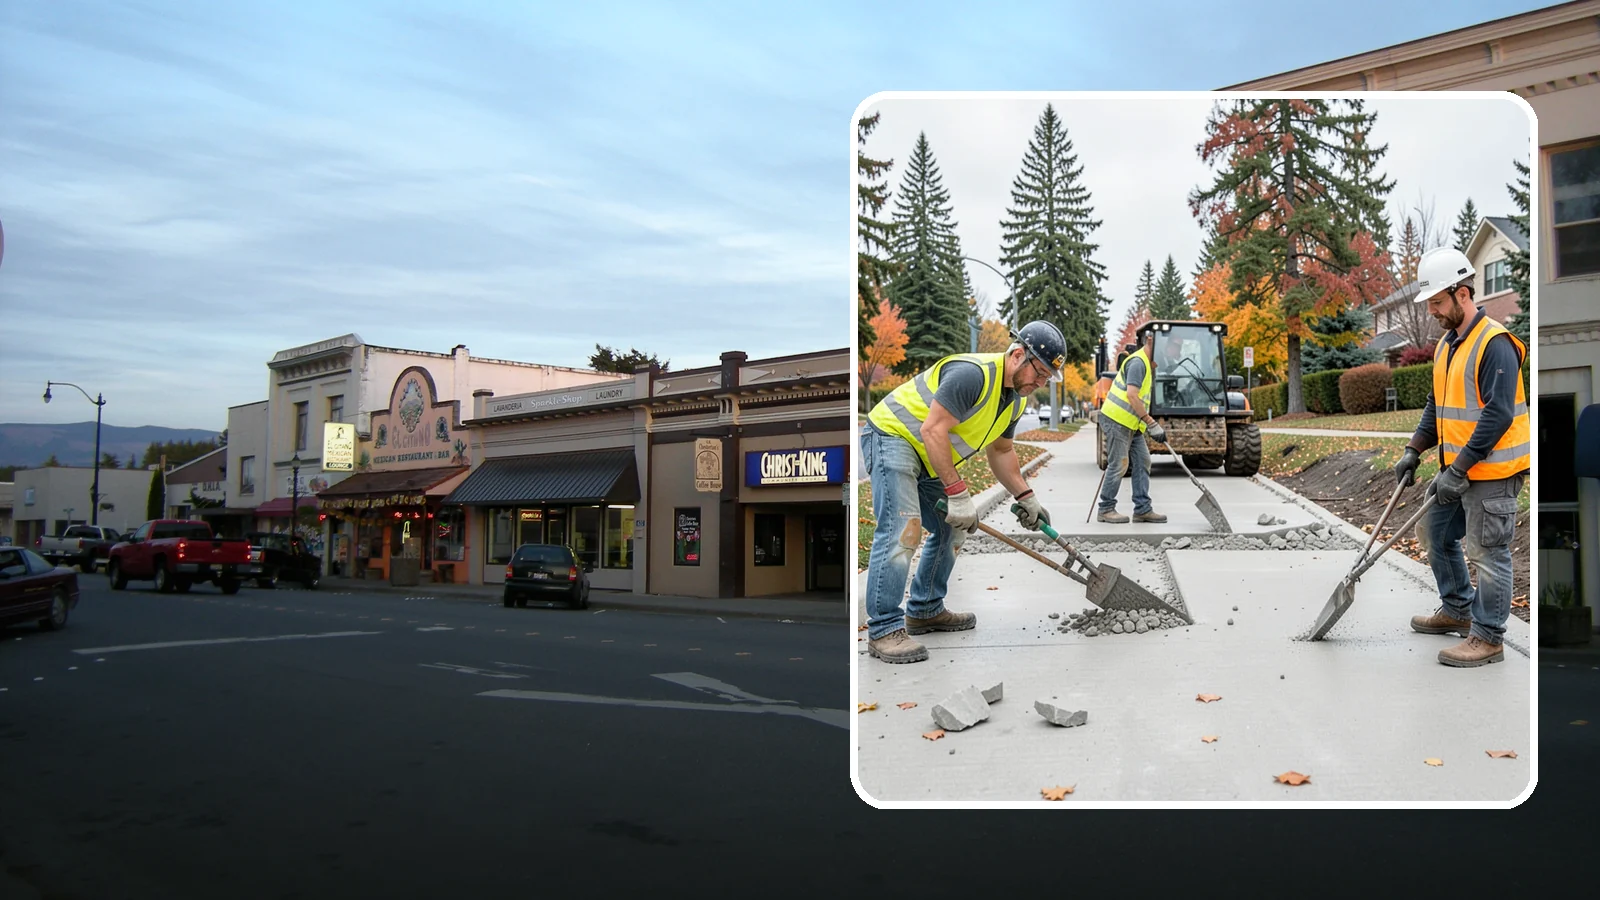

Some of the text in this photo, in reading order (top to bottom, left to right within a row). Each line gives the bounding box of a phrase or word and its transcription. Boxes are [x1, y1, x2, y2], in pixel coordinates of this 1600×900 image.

[493, 389, 623, 412] LAVANDERIA Sparkle Shop LAUNDRY
[373, 455, 397, 464] MEXICAN
[397, 451, 433, 462] RESTAURANT
[438, 450, 450, 459] BAR
[761, 450, 827, 477] CHRIST KING
